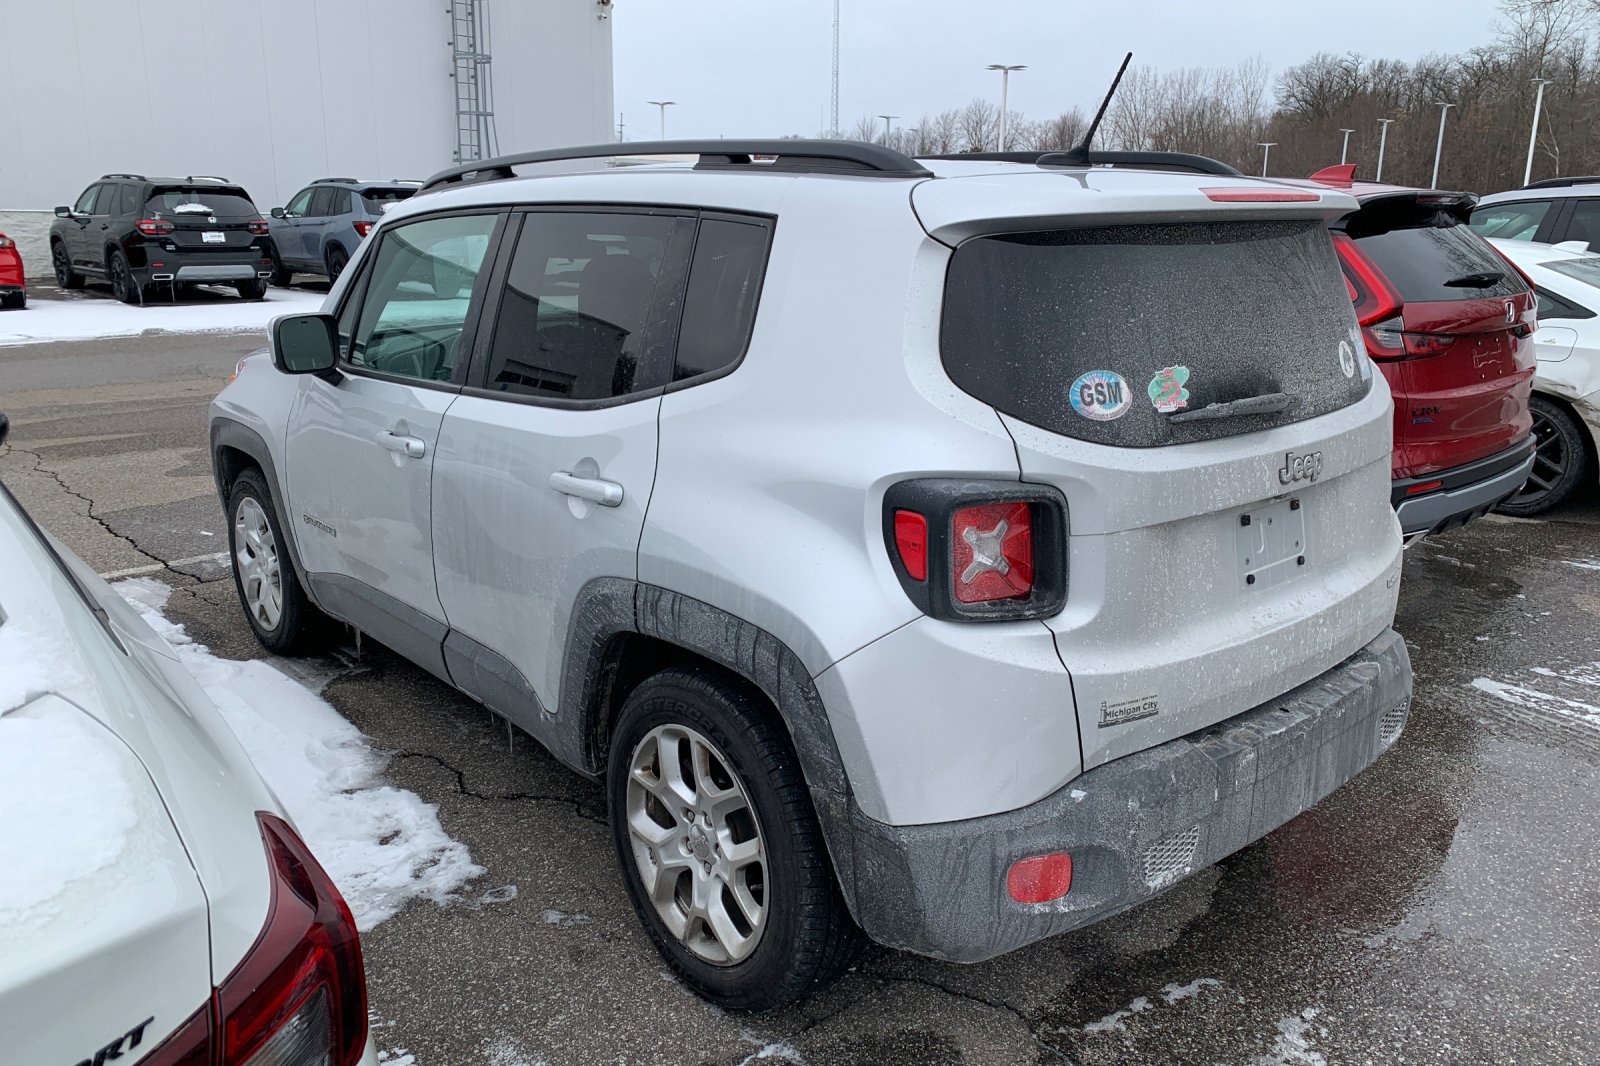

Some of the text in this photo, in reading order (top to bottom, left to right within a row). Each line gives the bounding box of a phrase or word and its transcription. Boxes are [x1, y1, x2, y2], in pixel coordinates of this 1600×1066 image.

[1079, 381, 1123, 407] GSM
[1278, 452, 1323, 485] Jeep
[1105, 705, 1141, 718] Michigan
[1142, 701, 1158, 710] City
[73, 1015, 155, 1066] RT
